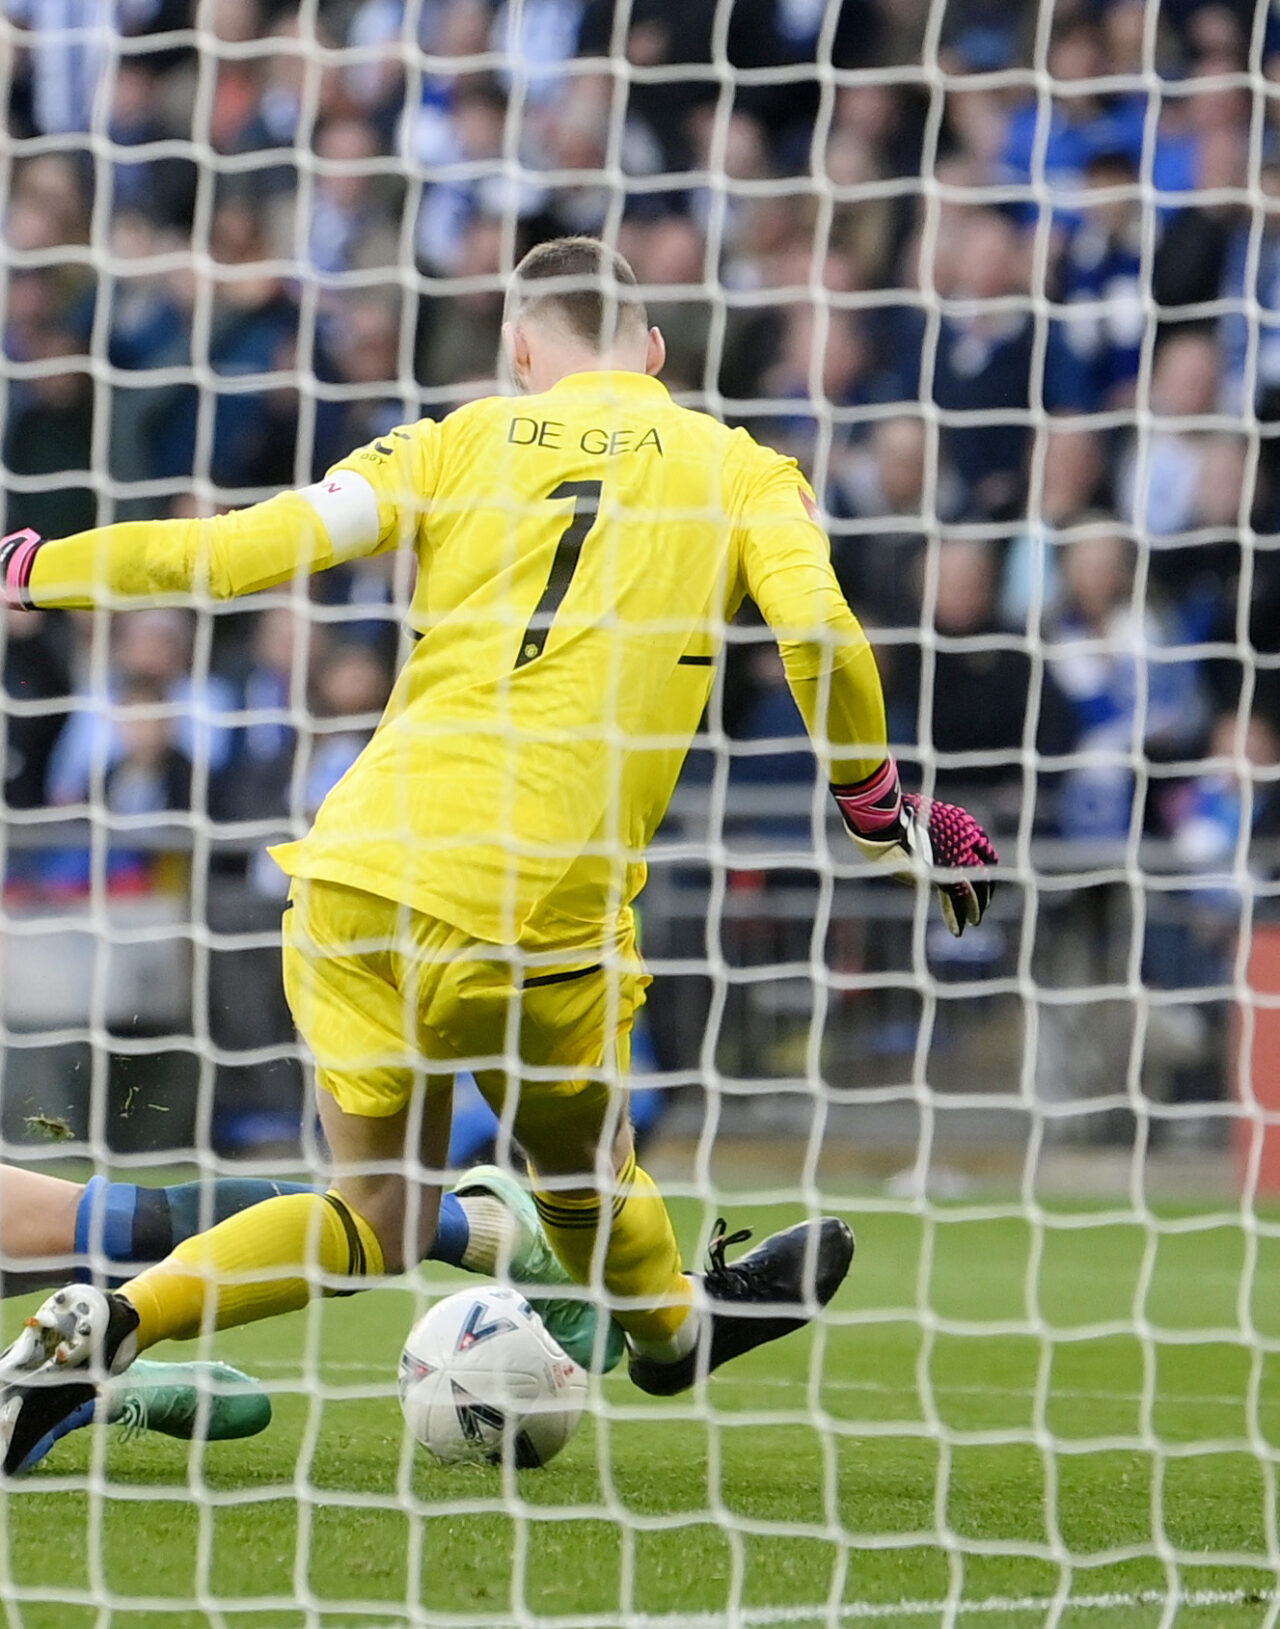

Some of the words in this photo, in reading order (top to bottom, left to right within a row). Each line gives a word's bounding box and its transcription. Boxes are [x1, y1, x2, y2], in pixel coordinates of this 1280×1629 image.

[508, 417, 566, 450] DE
[580, 428, 663, 457] GEA
[515, 479, 604, 669] 1
